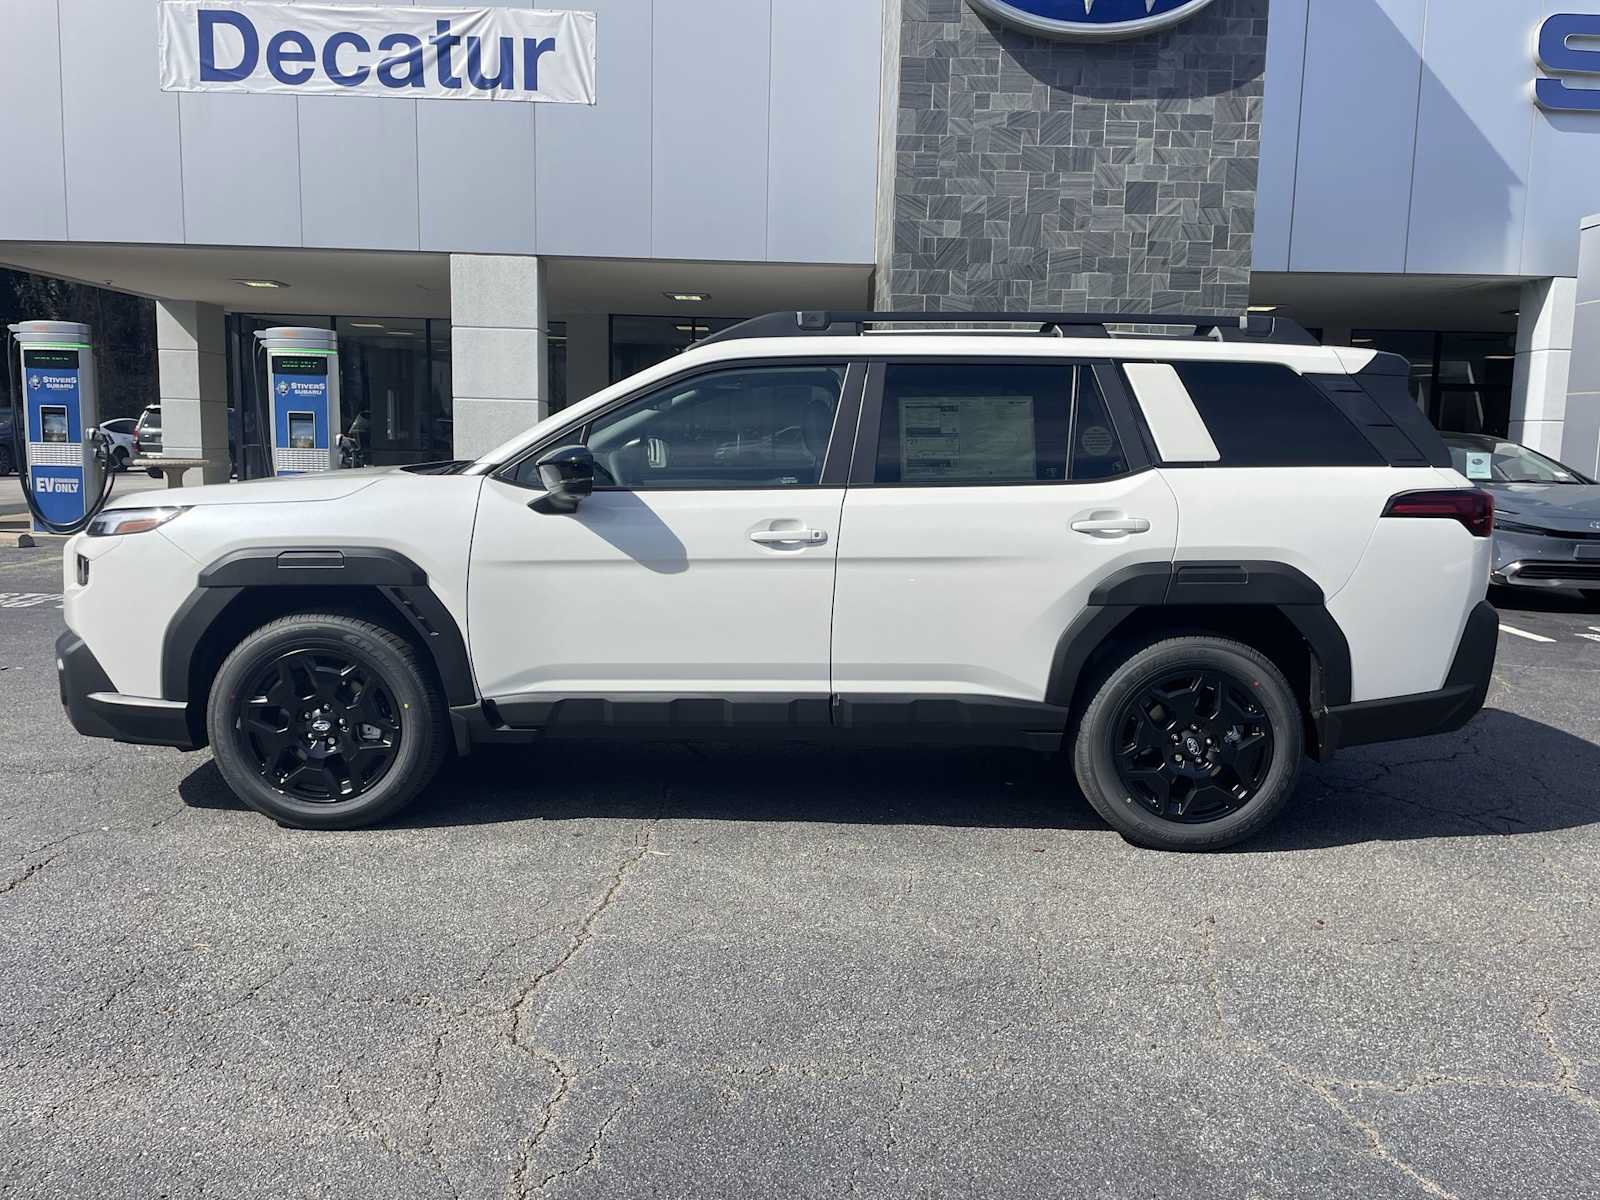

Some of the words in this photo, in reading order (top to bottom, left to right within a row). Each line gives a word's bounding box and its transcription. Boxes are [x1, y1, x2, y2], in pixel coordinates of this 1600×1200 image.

[198, 9, 556, 91] Decatur
[36, 477, 55, 493] EV
[55, 483, 79, 493] ONLY
